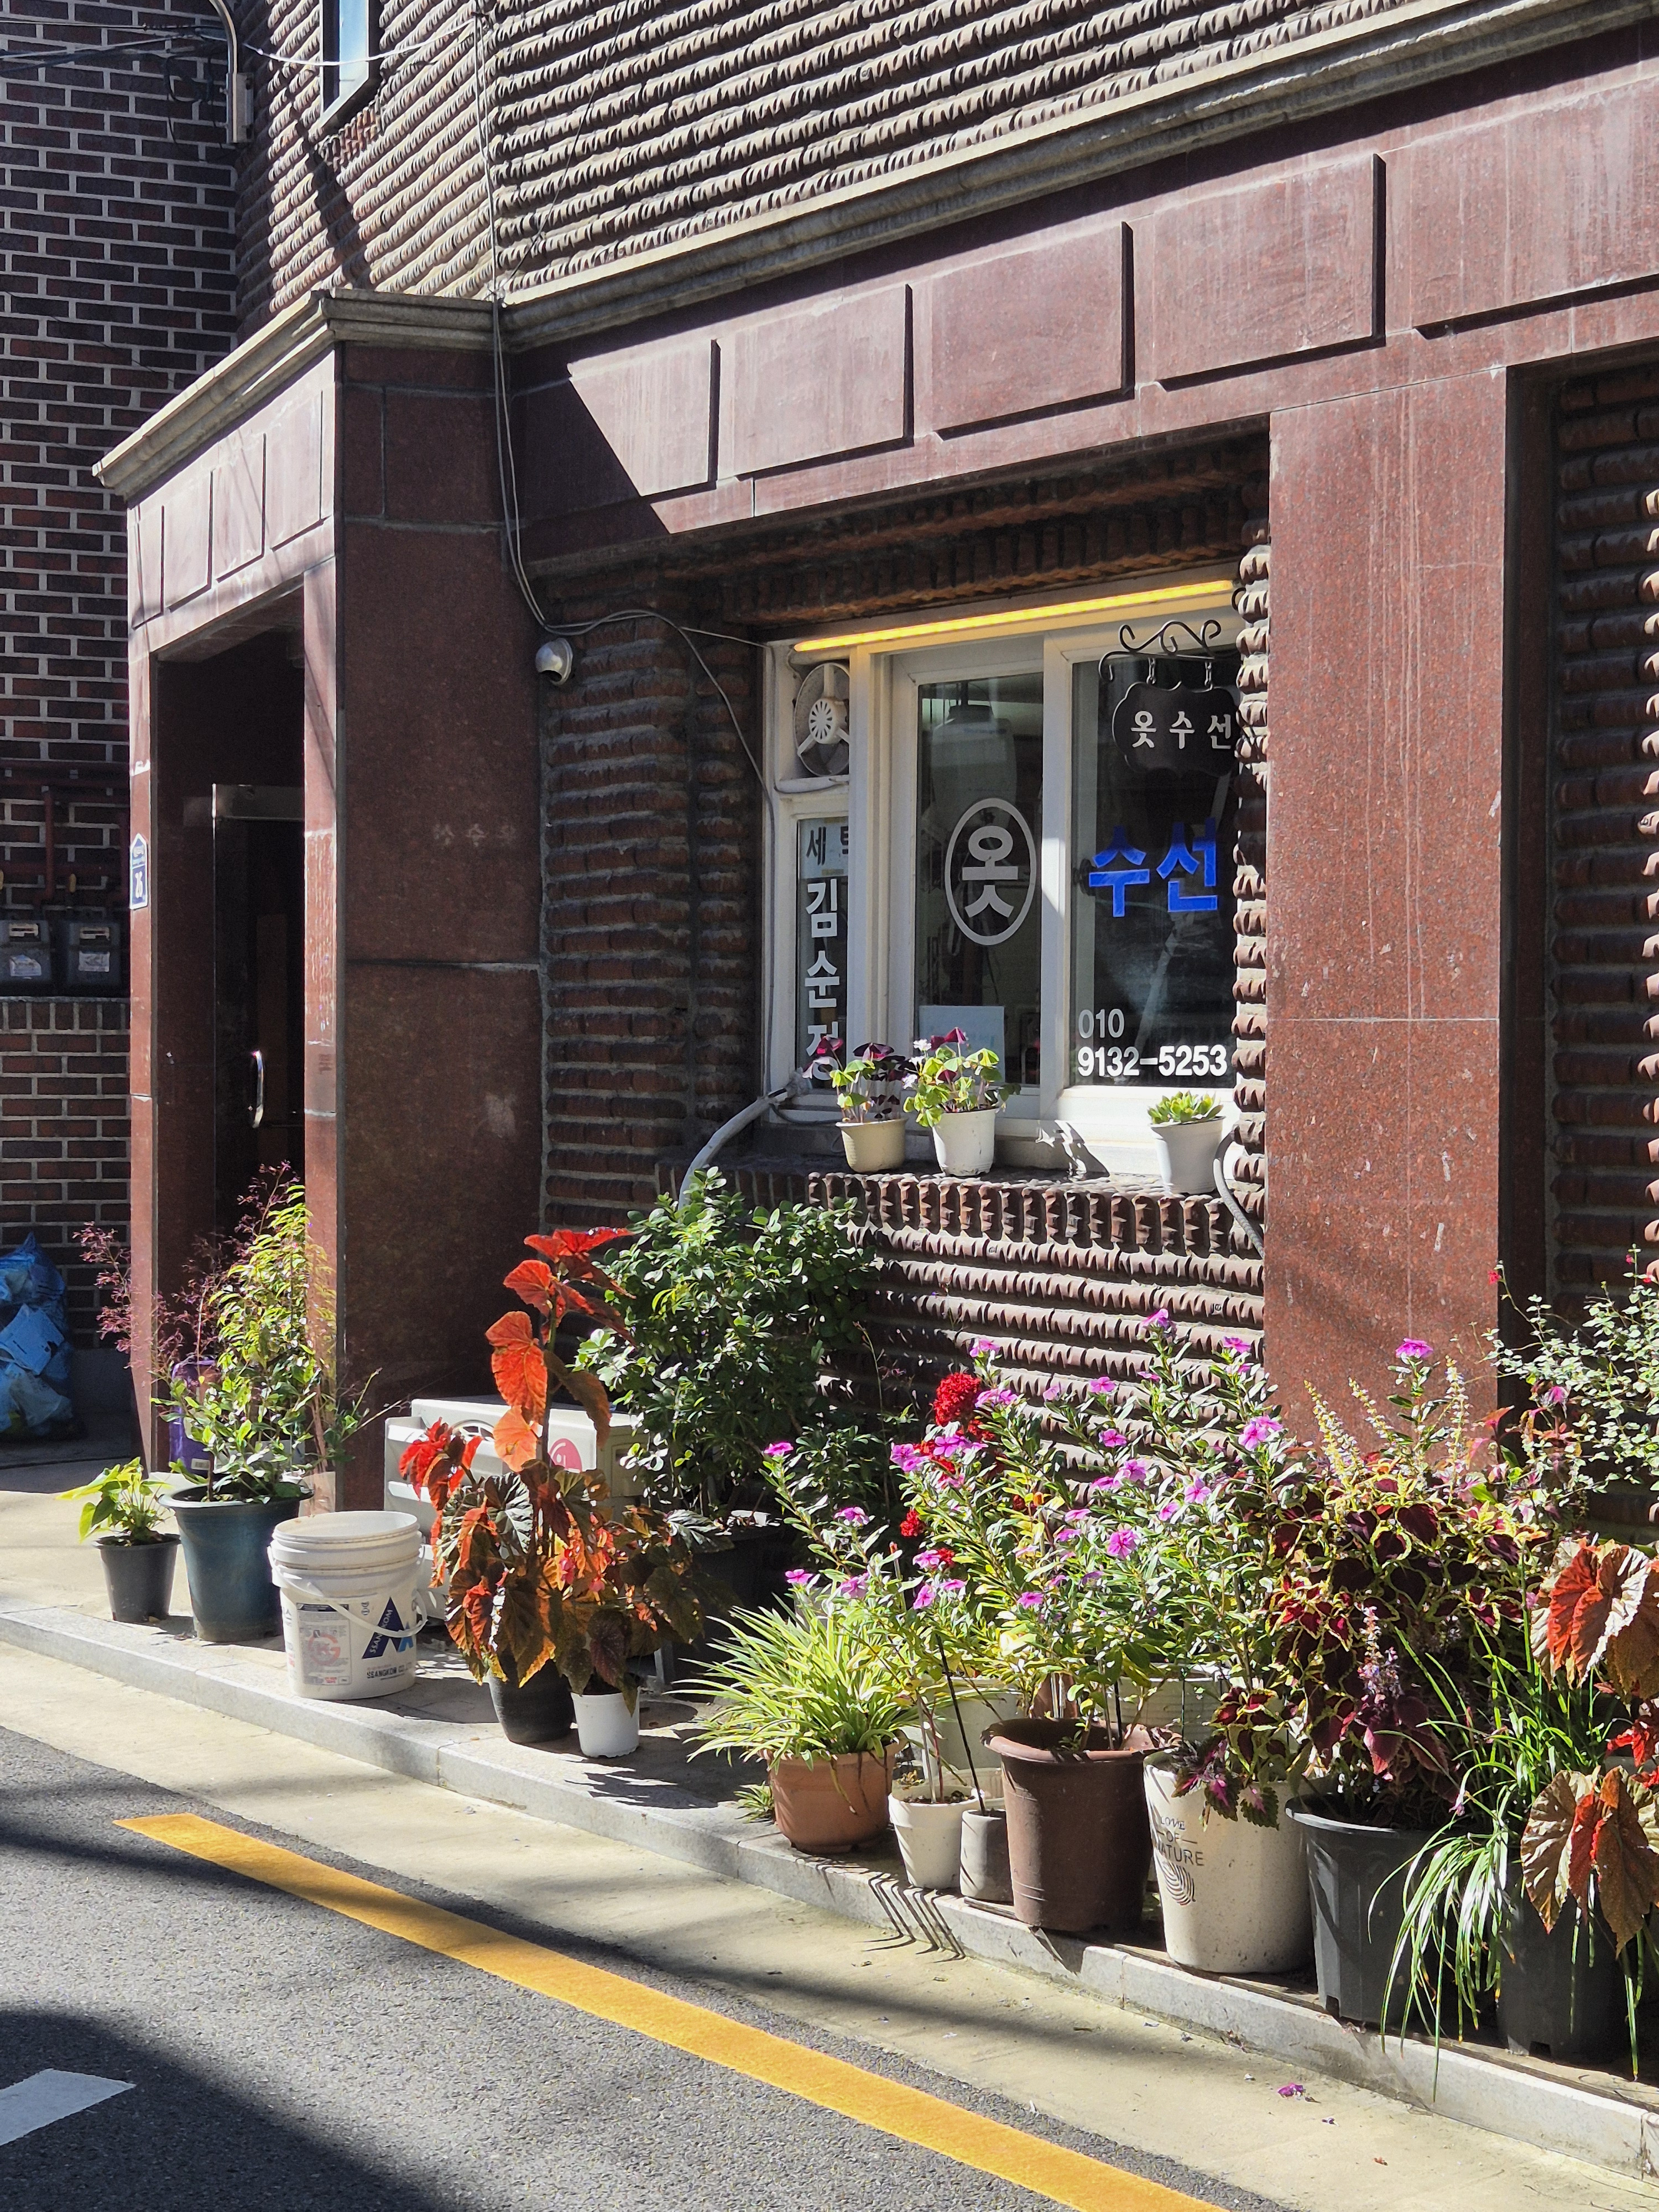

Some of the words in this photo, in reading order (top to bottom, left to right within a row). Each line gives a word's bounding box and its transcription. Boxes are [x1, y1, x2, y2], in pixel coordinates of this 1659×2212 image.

[1089, 817, 1218, 917] 수선
[1078, 1009, 1125, 1039] 010
[1078, 1044, 1228, 1077] 9132-5253
[1160, 1817, 1186, 1830] LOVE
